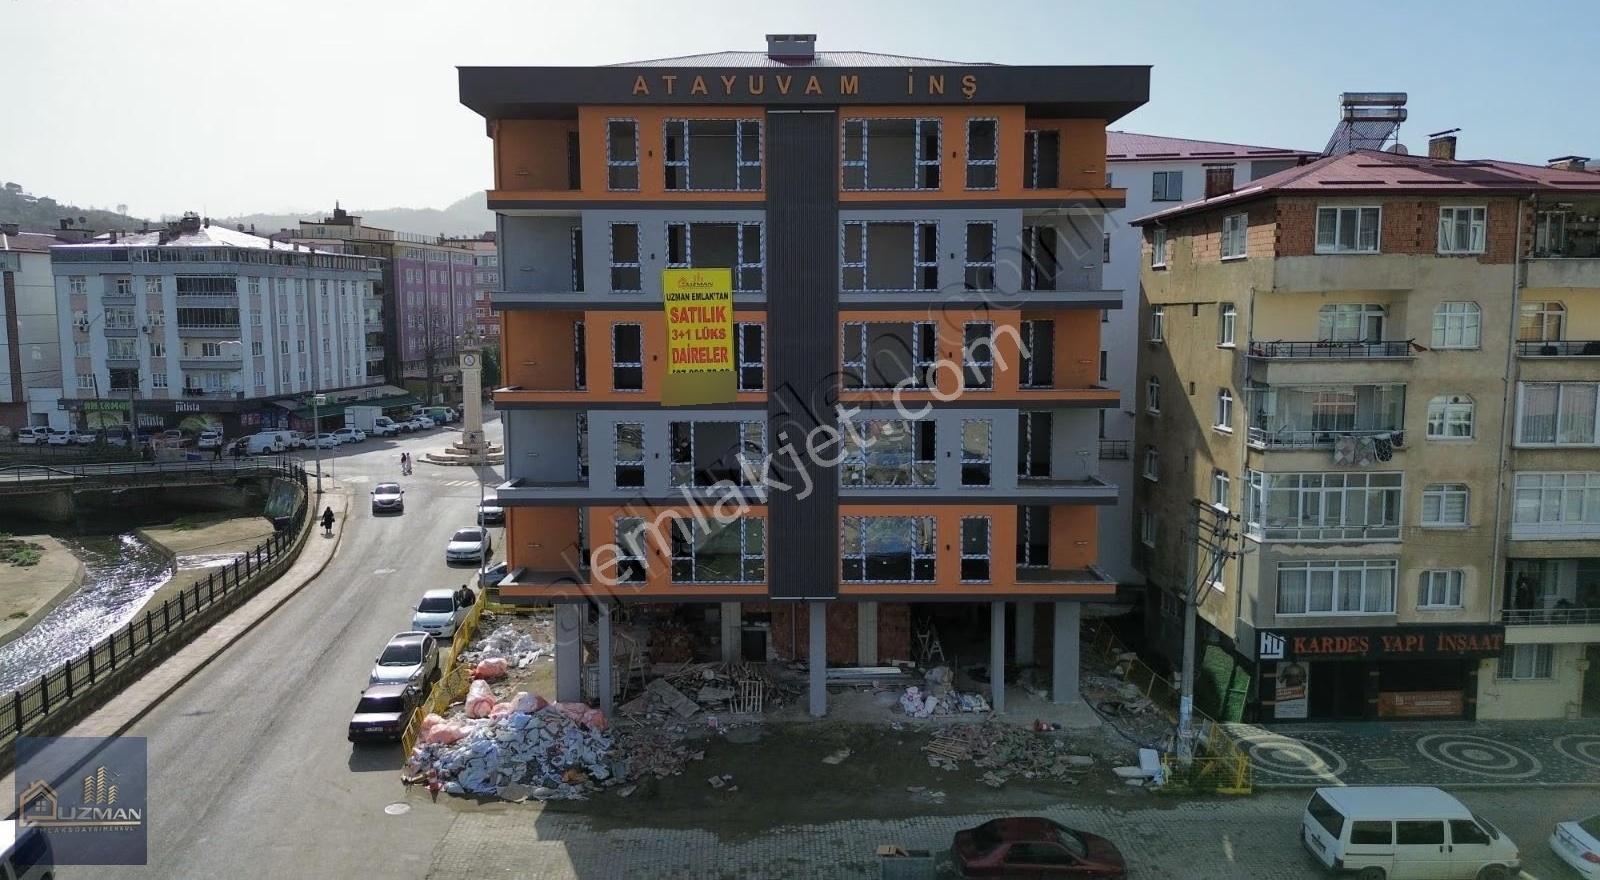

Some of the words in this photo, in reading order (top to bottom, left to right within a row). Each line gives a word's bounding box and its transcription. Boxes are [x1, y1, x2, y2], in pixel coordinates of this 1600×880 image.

[632, 74, 860, 96] ATAYUVAM
[907, 67, 978, 100] İNŞ
[666, 292, 690, 302] UZMAN
[691, 291, 729, 301] EMLAK'TAN
[670, 305, 727, 324] SATILIK
[671, 327, 692, 341] 3+1
[695, 326, 727, 340] LÜKS
[671, 343, 729, 364] DAİRELER
[1293, 635, 1370, 656] KARDEŞ
[1380, 634, 1426, 652] YAPI
[1437, 631, 1506, 655] İNŞAAT
